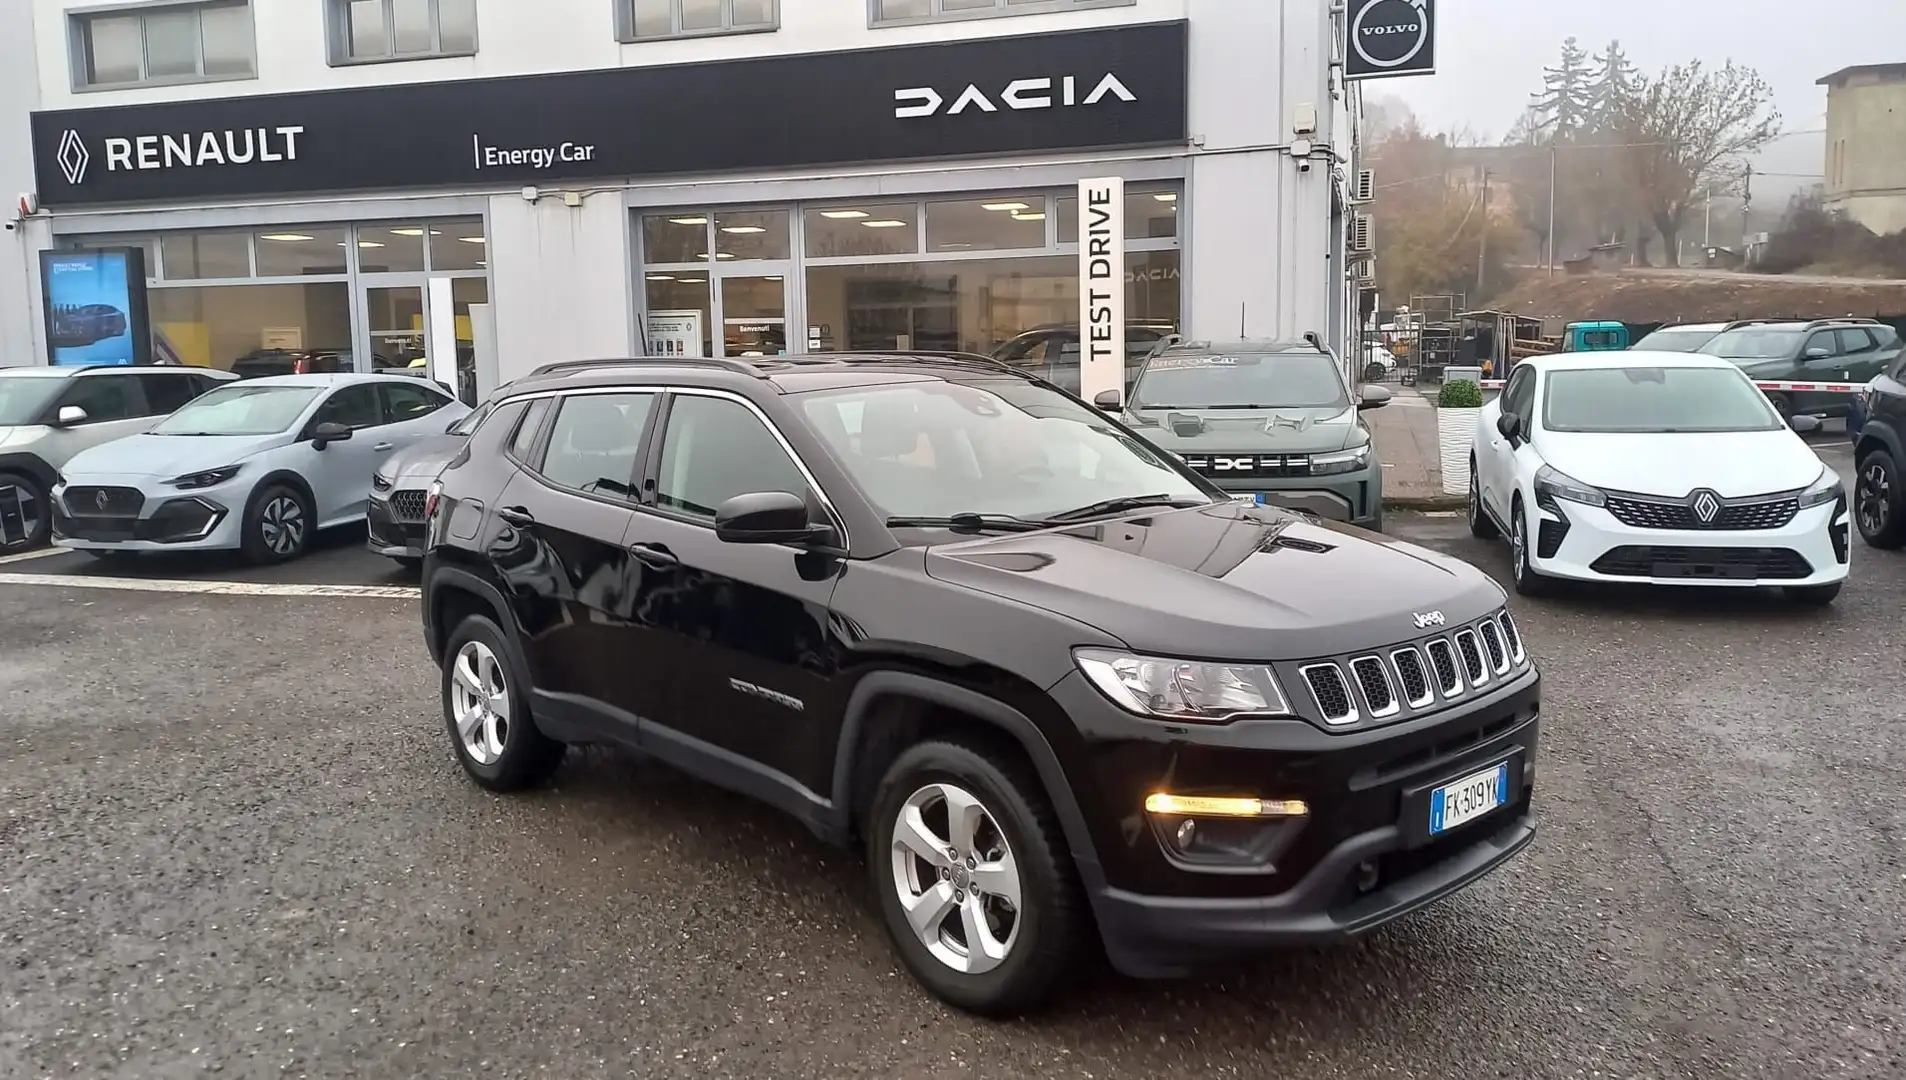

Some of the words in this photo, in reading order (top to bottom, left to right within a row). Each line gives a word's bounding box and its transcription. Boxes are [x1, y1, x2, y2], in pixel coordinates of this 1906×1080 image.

[1362, 23, 1418, 36] VOLVO
[895, 72, 1138, 118] DACIA
[105, 126, 304, 171] RENAULT
[484, 146, 555, 169] Energy
[559, 142, 595, 162] Car
[1088, 187, 1111, 280] DRIVE
[1089, 288, 1112, 361] TEST
[1412, 609, 1446, 629] Jeep
